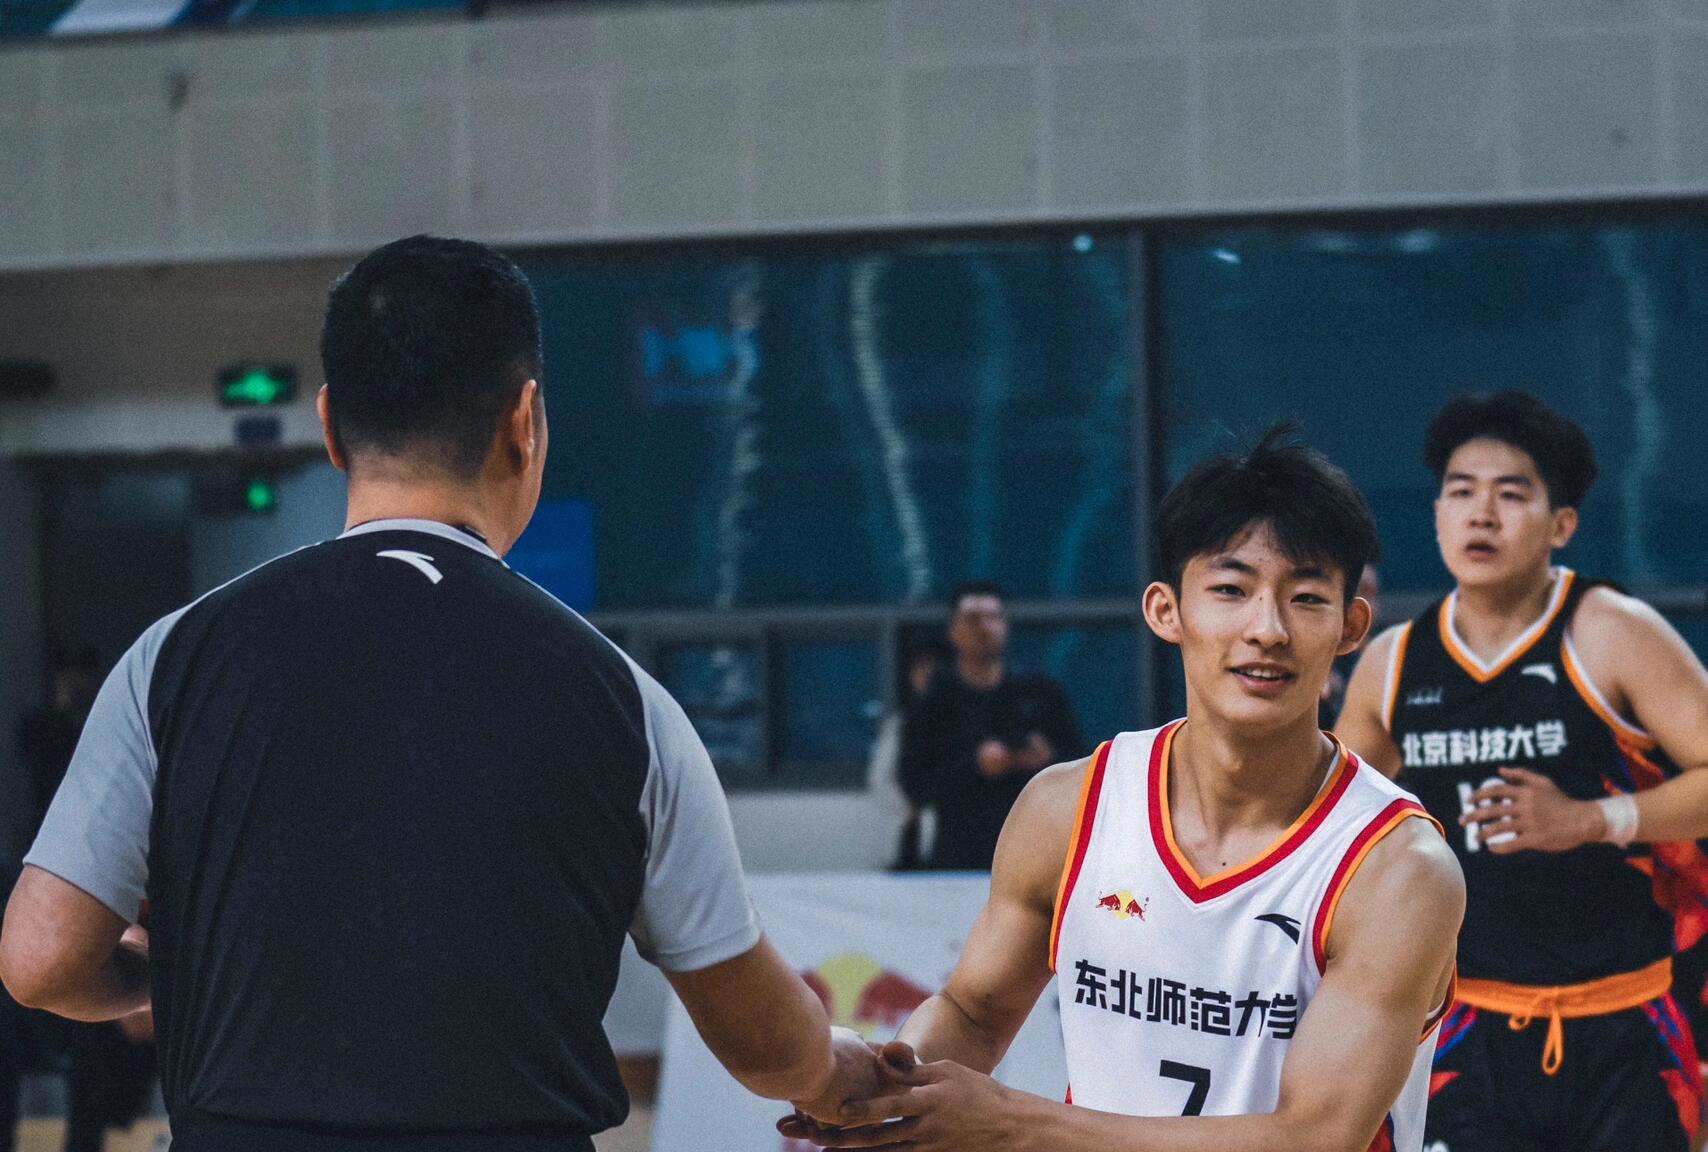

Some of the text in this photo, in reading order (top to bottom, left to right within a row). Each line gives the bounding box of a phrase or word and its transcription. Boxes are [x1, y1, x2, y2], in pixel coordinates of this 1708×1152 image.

[1402, 719, 1568, 768] 北京科技大学
[1074, 958, 1298, 1040] 东北师范大学
[1159, 1058, 1212, 1117] 7
